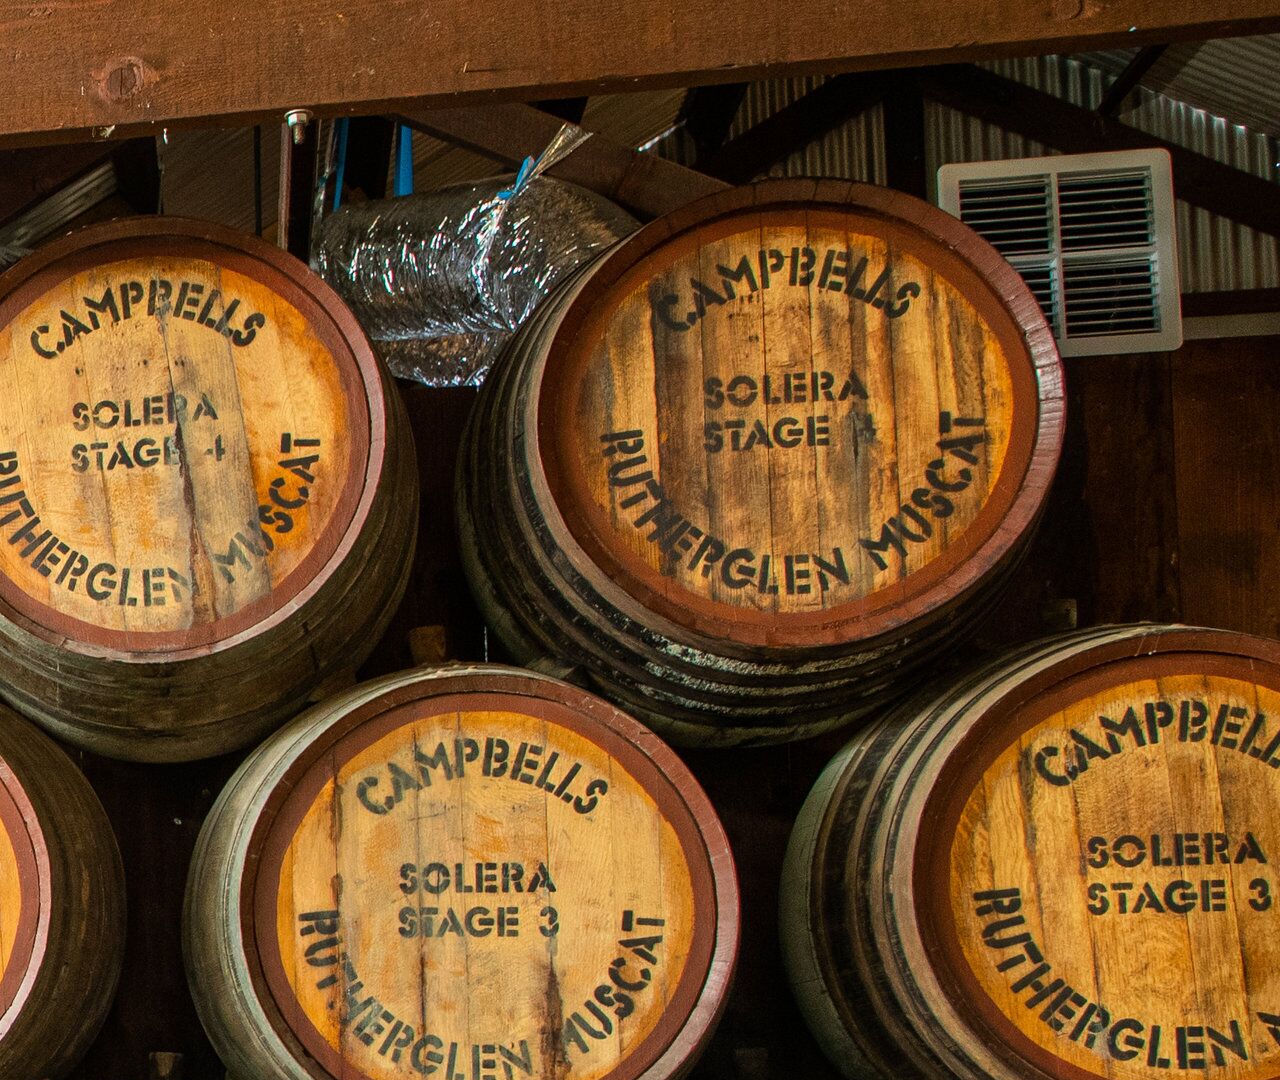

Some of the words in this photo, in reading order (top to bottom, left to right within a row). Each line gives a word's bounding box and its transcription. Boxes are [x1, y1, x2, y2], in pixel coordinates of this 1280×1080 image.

[653, 246, 921, 333] CAMPBELLS
[30, 278, 265, 360] CAMPBELLS
[703, 370, 869, 411] SOLERA
[72, 392, 220, 431] SOLERA
[71, 437, 182, 473] STAGE
[206, 433, 225, 462] 4
[703, 415, 830, 454] STAGE
[213, 433, 321, 583] MUSCAT
[600, 428, 850, 595] RUTHERGLEN
[860, 410, 986, 572] MUSCAT
[356, 736, 609, 816] CAMPBELLS
[1087, 831, 1268, 870] SOLERA
[399, 861, 558, 895] SOLERA
[1087, 878, 1227, 916] STAGE
[1248, 877, 1272, 913] 3
[398, 906, 519, 939] STAGE
[539, 906, 559, 938] 3
[973, 886, 1249, 1070] RUTHERGLEN
